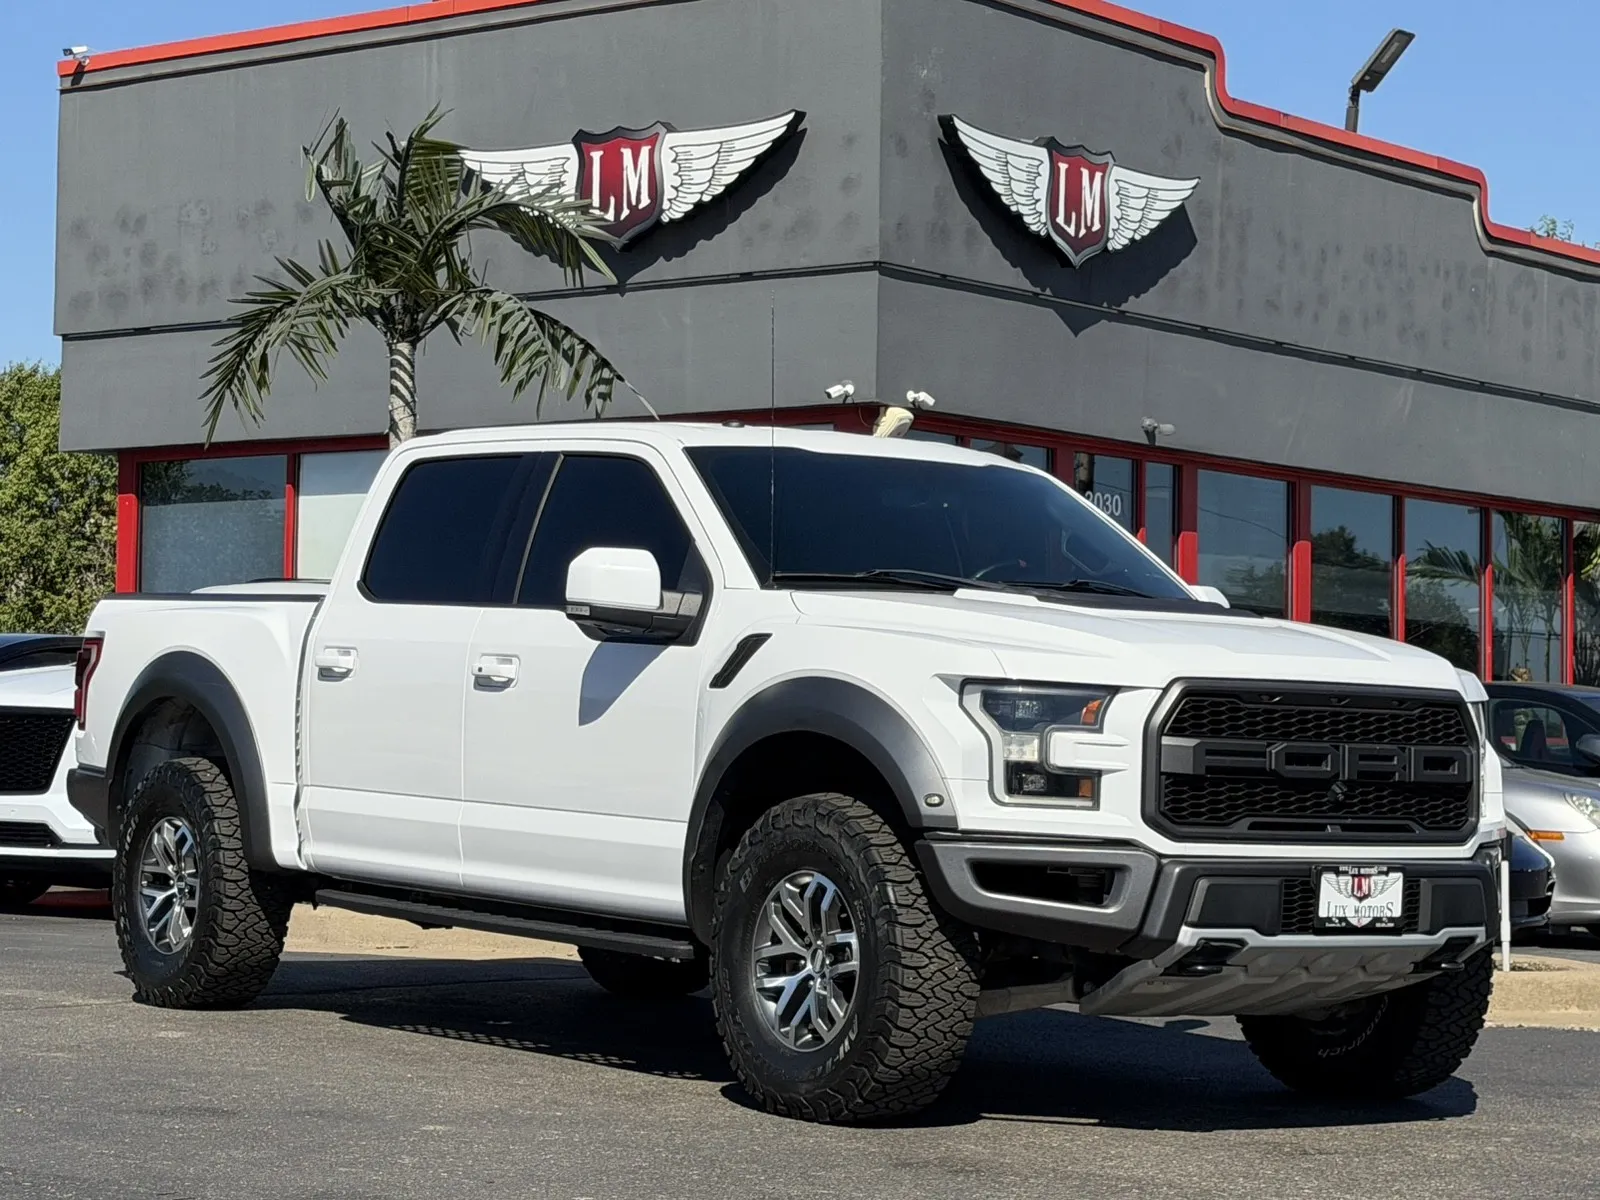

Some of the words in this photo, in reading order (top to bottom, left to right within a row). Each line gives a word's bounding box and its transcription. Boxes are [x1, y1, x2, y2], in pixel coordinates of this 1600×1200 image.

[589, 144, 653, 222] LM
[1056, 162, 1103, 239] LM
[1190, 738, 1476, 783] FORD
[1327, 901, 1348, 918] LUX
[1353, 901, 1395, 918] MOTORS
